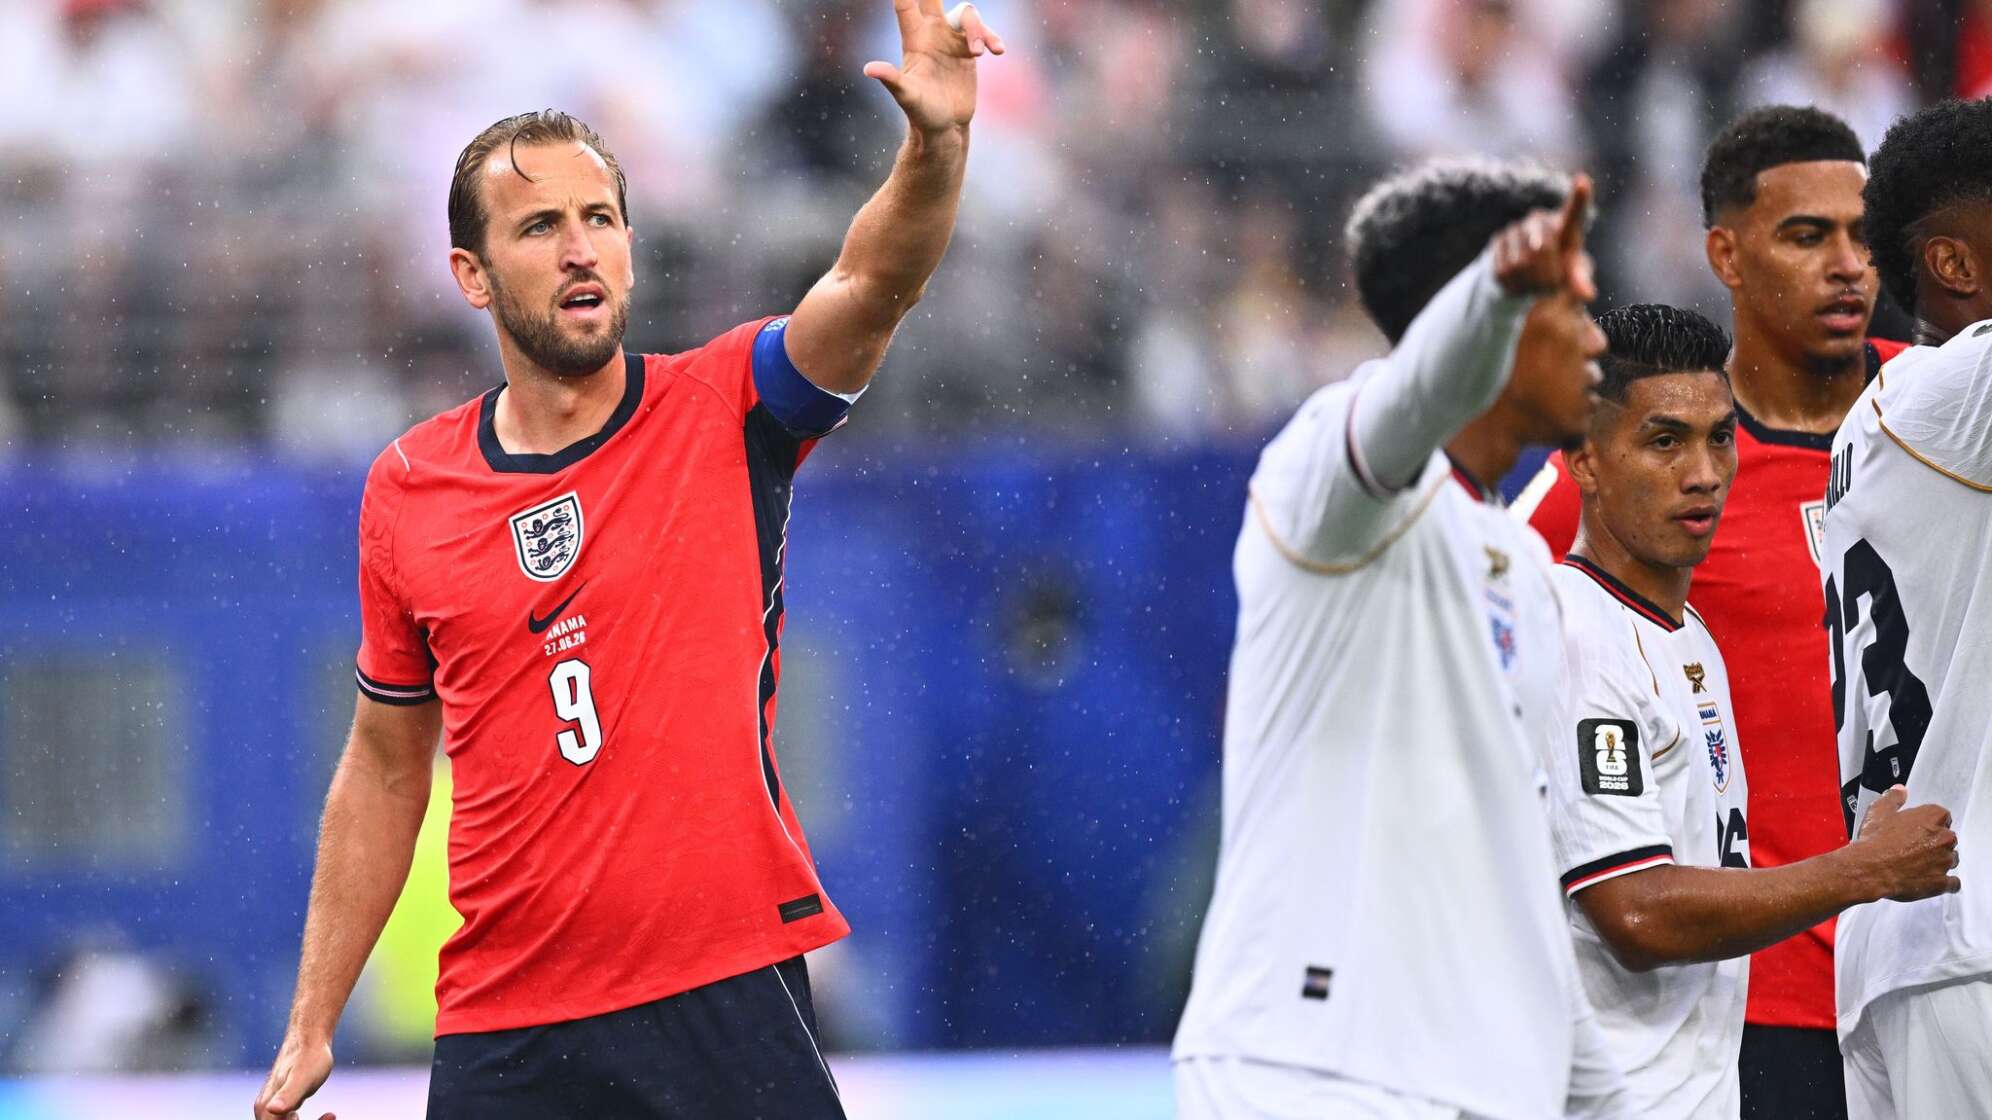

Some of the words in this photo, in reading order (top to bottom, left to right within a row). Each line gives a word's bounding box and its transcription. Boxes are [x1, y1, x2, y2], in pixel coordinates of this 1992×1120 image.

[546, 614, 587, 641] ANAMA
[548, 657, 603, 766] 9
[1716, 807, 1749, 868] 6
